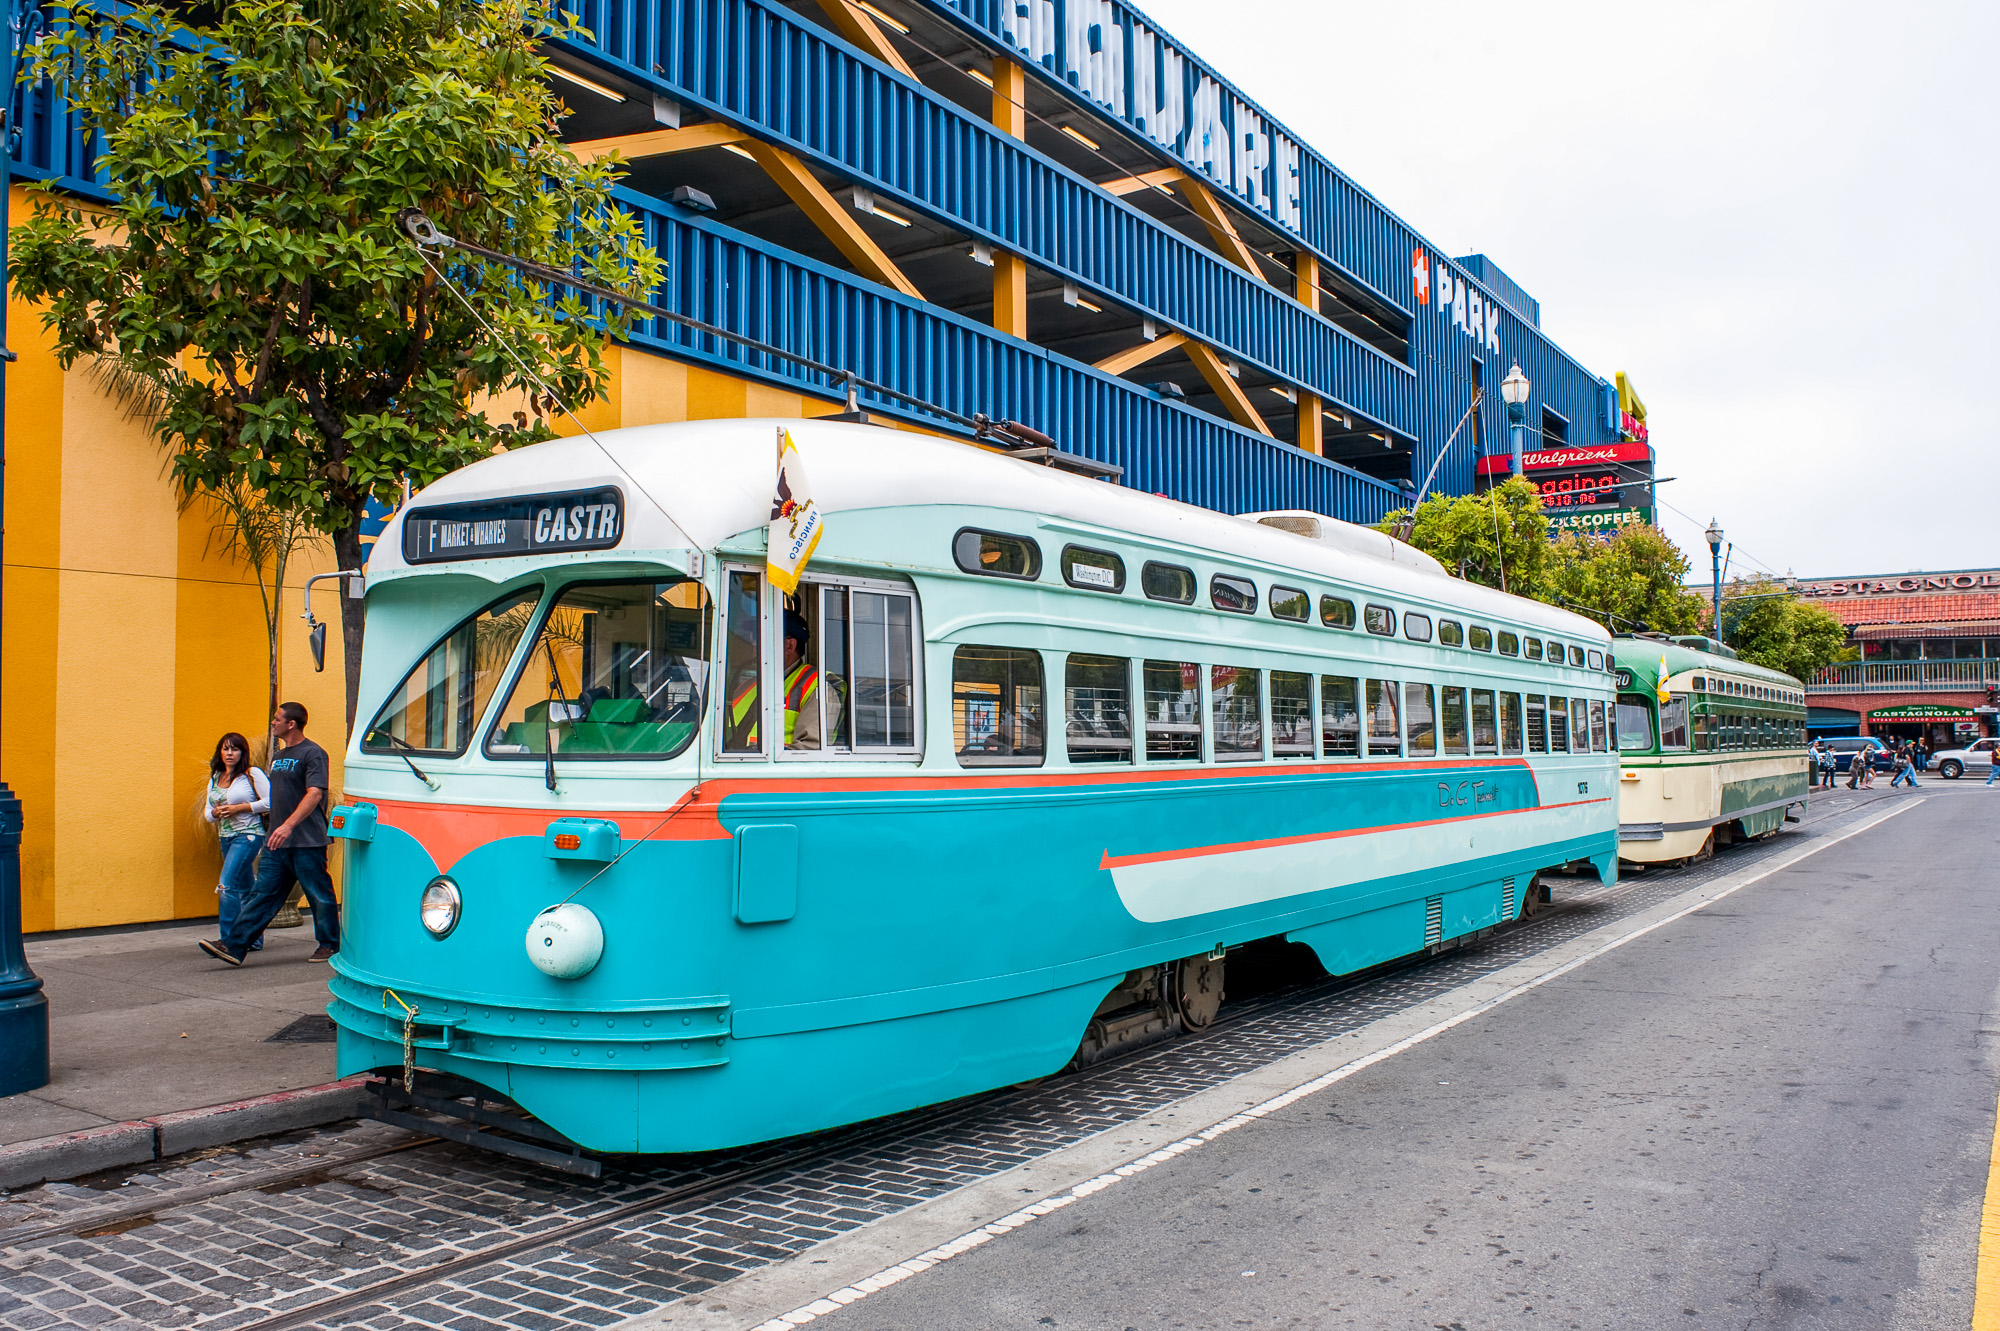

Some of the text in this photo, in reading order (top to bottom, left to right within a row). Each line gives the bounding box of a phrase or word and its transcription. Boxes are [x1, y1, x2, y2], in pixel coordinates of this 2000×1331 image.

[1437, 263, 1499, 355] PARK
[1522, 448, 1618, 466] Walgreens
[1582, 511, 1641, 526] COFFEE
[429, 520, 438, 553] F
[440, 522, 471, 548] MARKET
[474, 519, 507, 546] WHARVES
[1075, 565, 1101, 583] Washington
